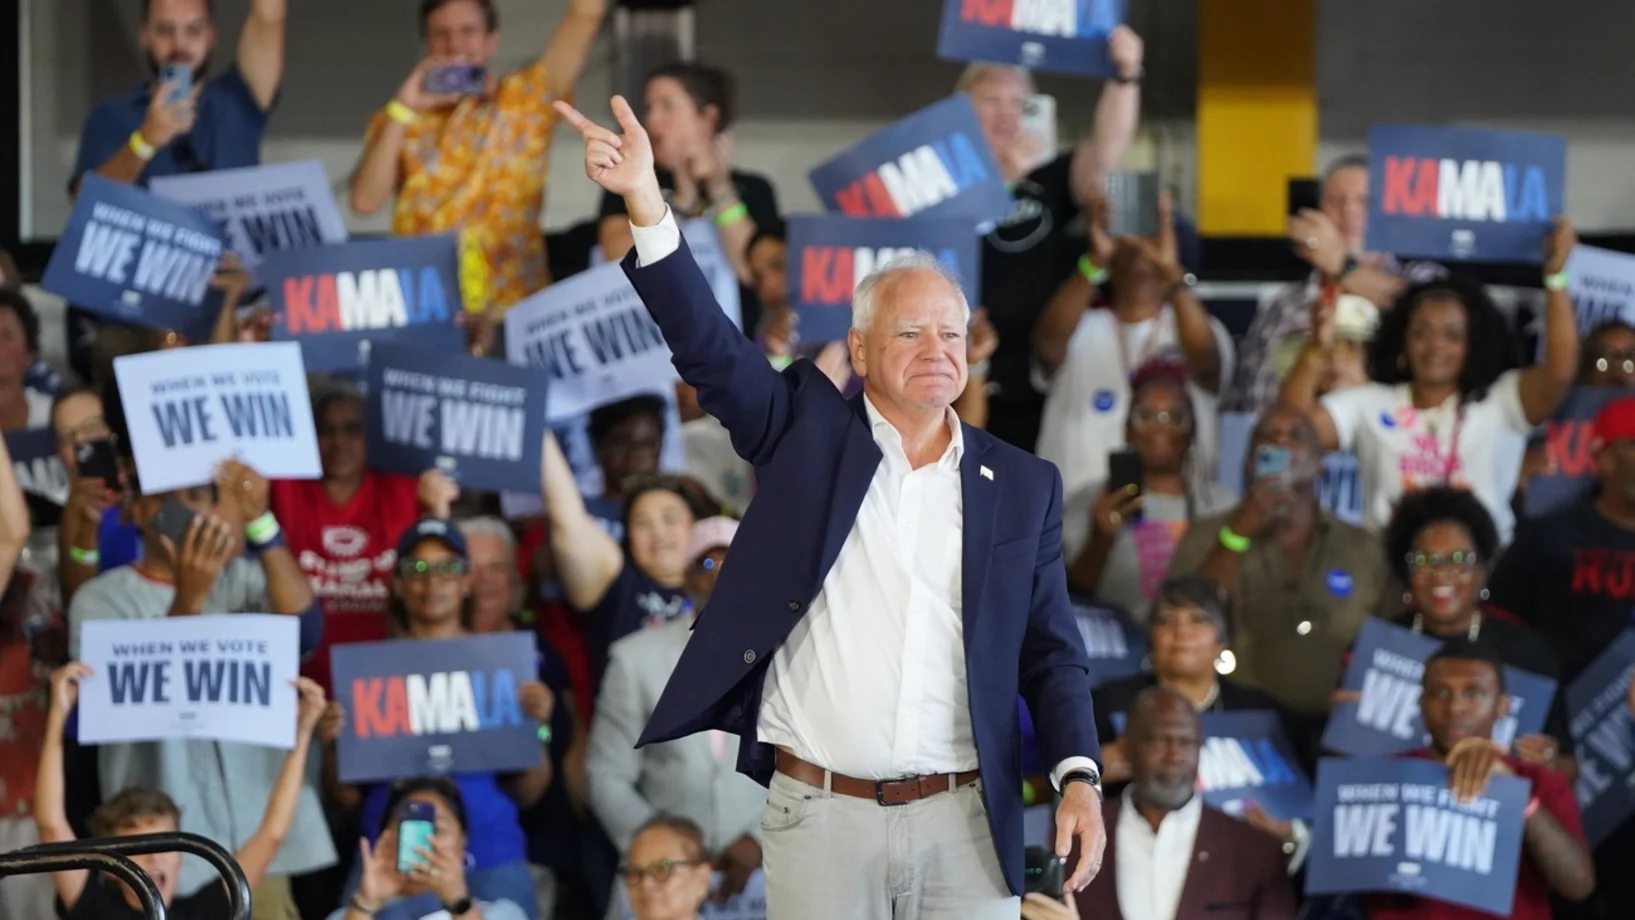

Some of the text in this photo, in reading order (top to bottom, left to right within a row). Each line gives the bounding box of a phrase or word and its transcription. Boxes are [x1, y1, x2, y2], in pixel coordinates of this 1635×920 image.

[835, 131, 990, 219] KAMALA
[1382, 156, 1550, 223] KAMALA
[93, 200, 222, 257] WHEN WE FIGHT
[241, 203, 324, 255] WIN
[74, 220, 219, 307] WE WIN
[282, 266, 450, 335] KAMALA
[524, 306, 665, 380] WE WIN
[151, 369, 282, 396] WHEN WE VOTE
[382, 367, 528, 407] WHEN WE FIGHT
[151, 391, 296, 449] WE WIN
[381, 389, 439, 450] WE
[440, 397, 526, 463] WIN
[111, 638, 269, 658] WHEN WE VOTE
[107, 658, 271, 707] WE WIN
[352, 668, 523, 739] KAMALA
[1356, 669, 1425, 741] WE
[1194, 736, 1297, 792] MALA
[1337, 784, 1399, 804] WHEN
[1401, 783, 1437, 803] WE
[1333, 803, 1498, 876] WE WIN
